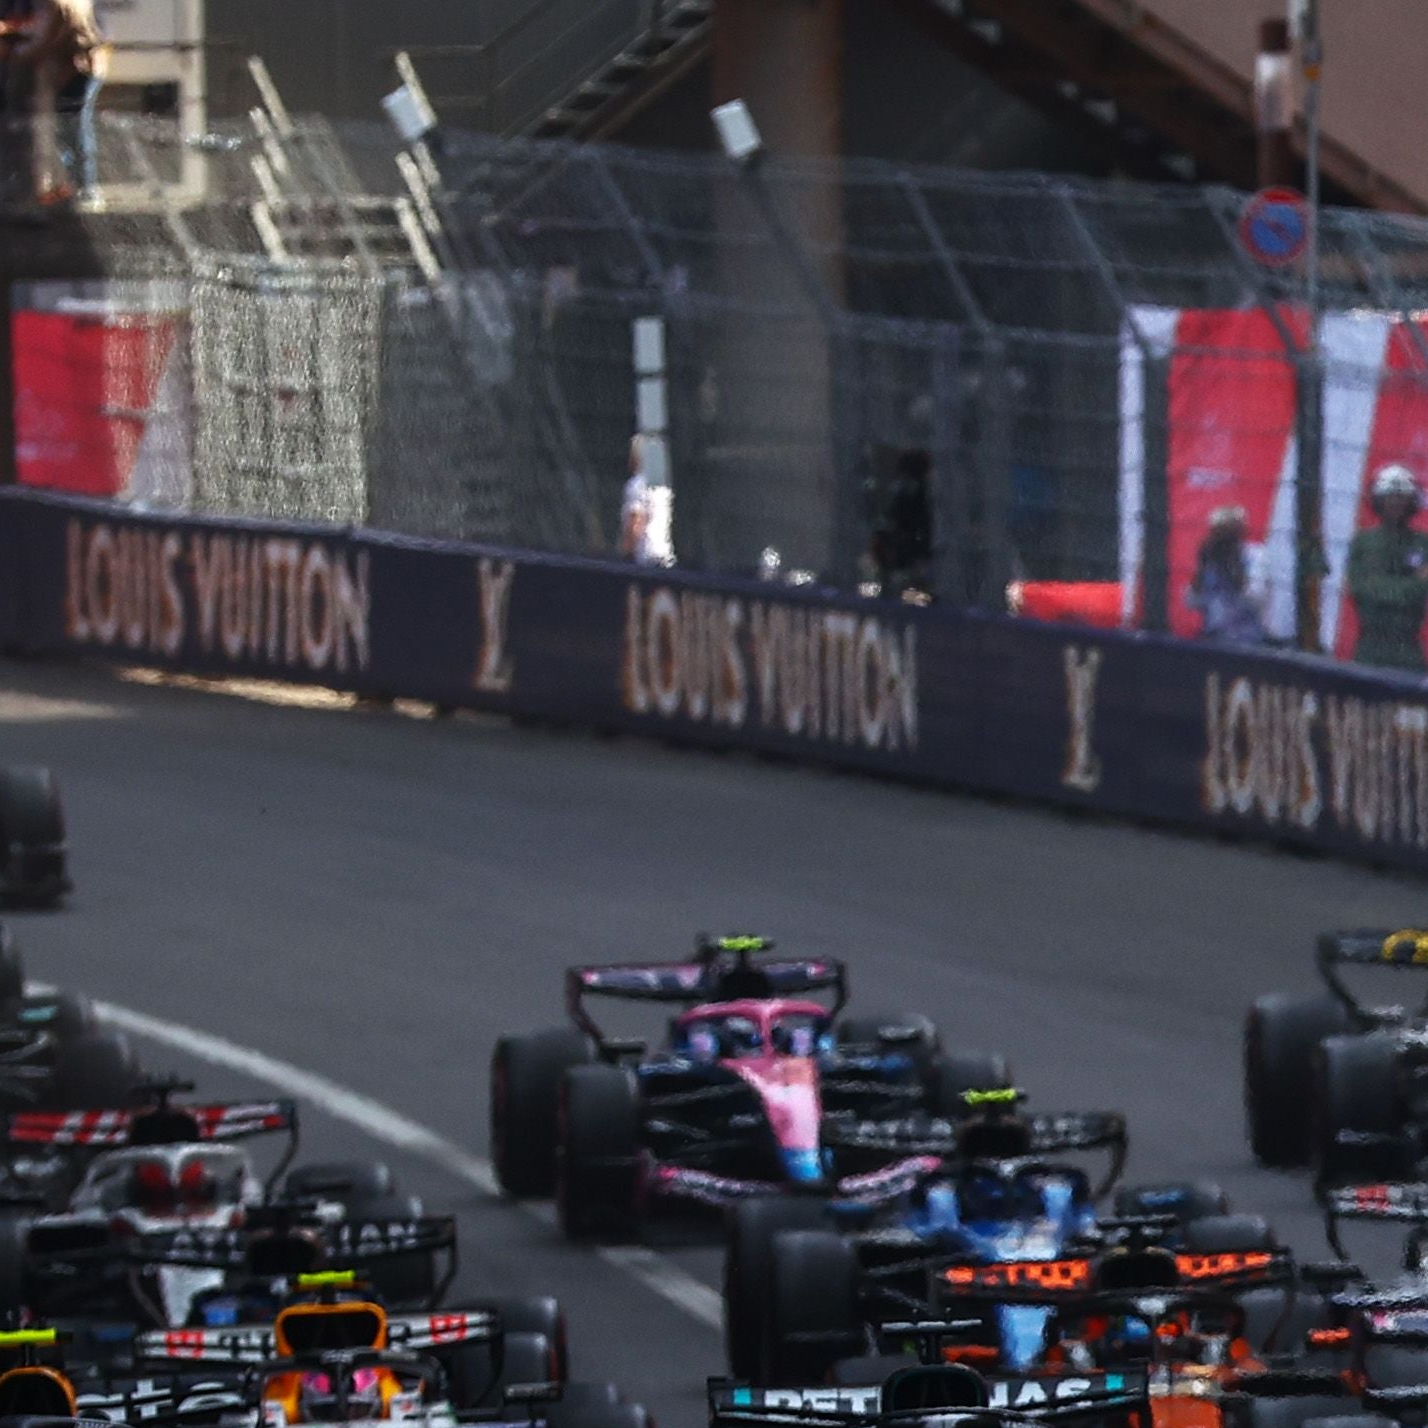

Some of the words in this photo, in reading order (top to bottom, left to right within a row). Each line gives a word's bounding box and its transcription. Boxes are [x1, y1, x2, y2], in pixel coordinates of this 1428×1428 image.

[67, 518, 186, 660] LOUIS
[190, 530, 369, 674] VUITTON
[624, 582, 747, 728] LOUIS
[751, 600, 918, 753] VUITTON
[1203, 672, 1322, 832] LOUIS
